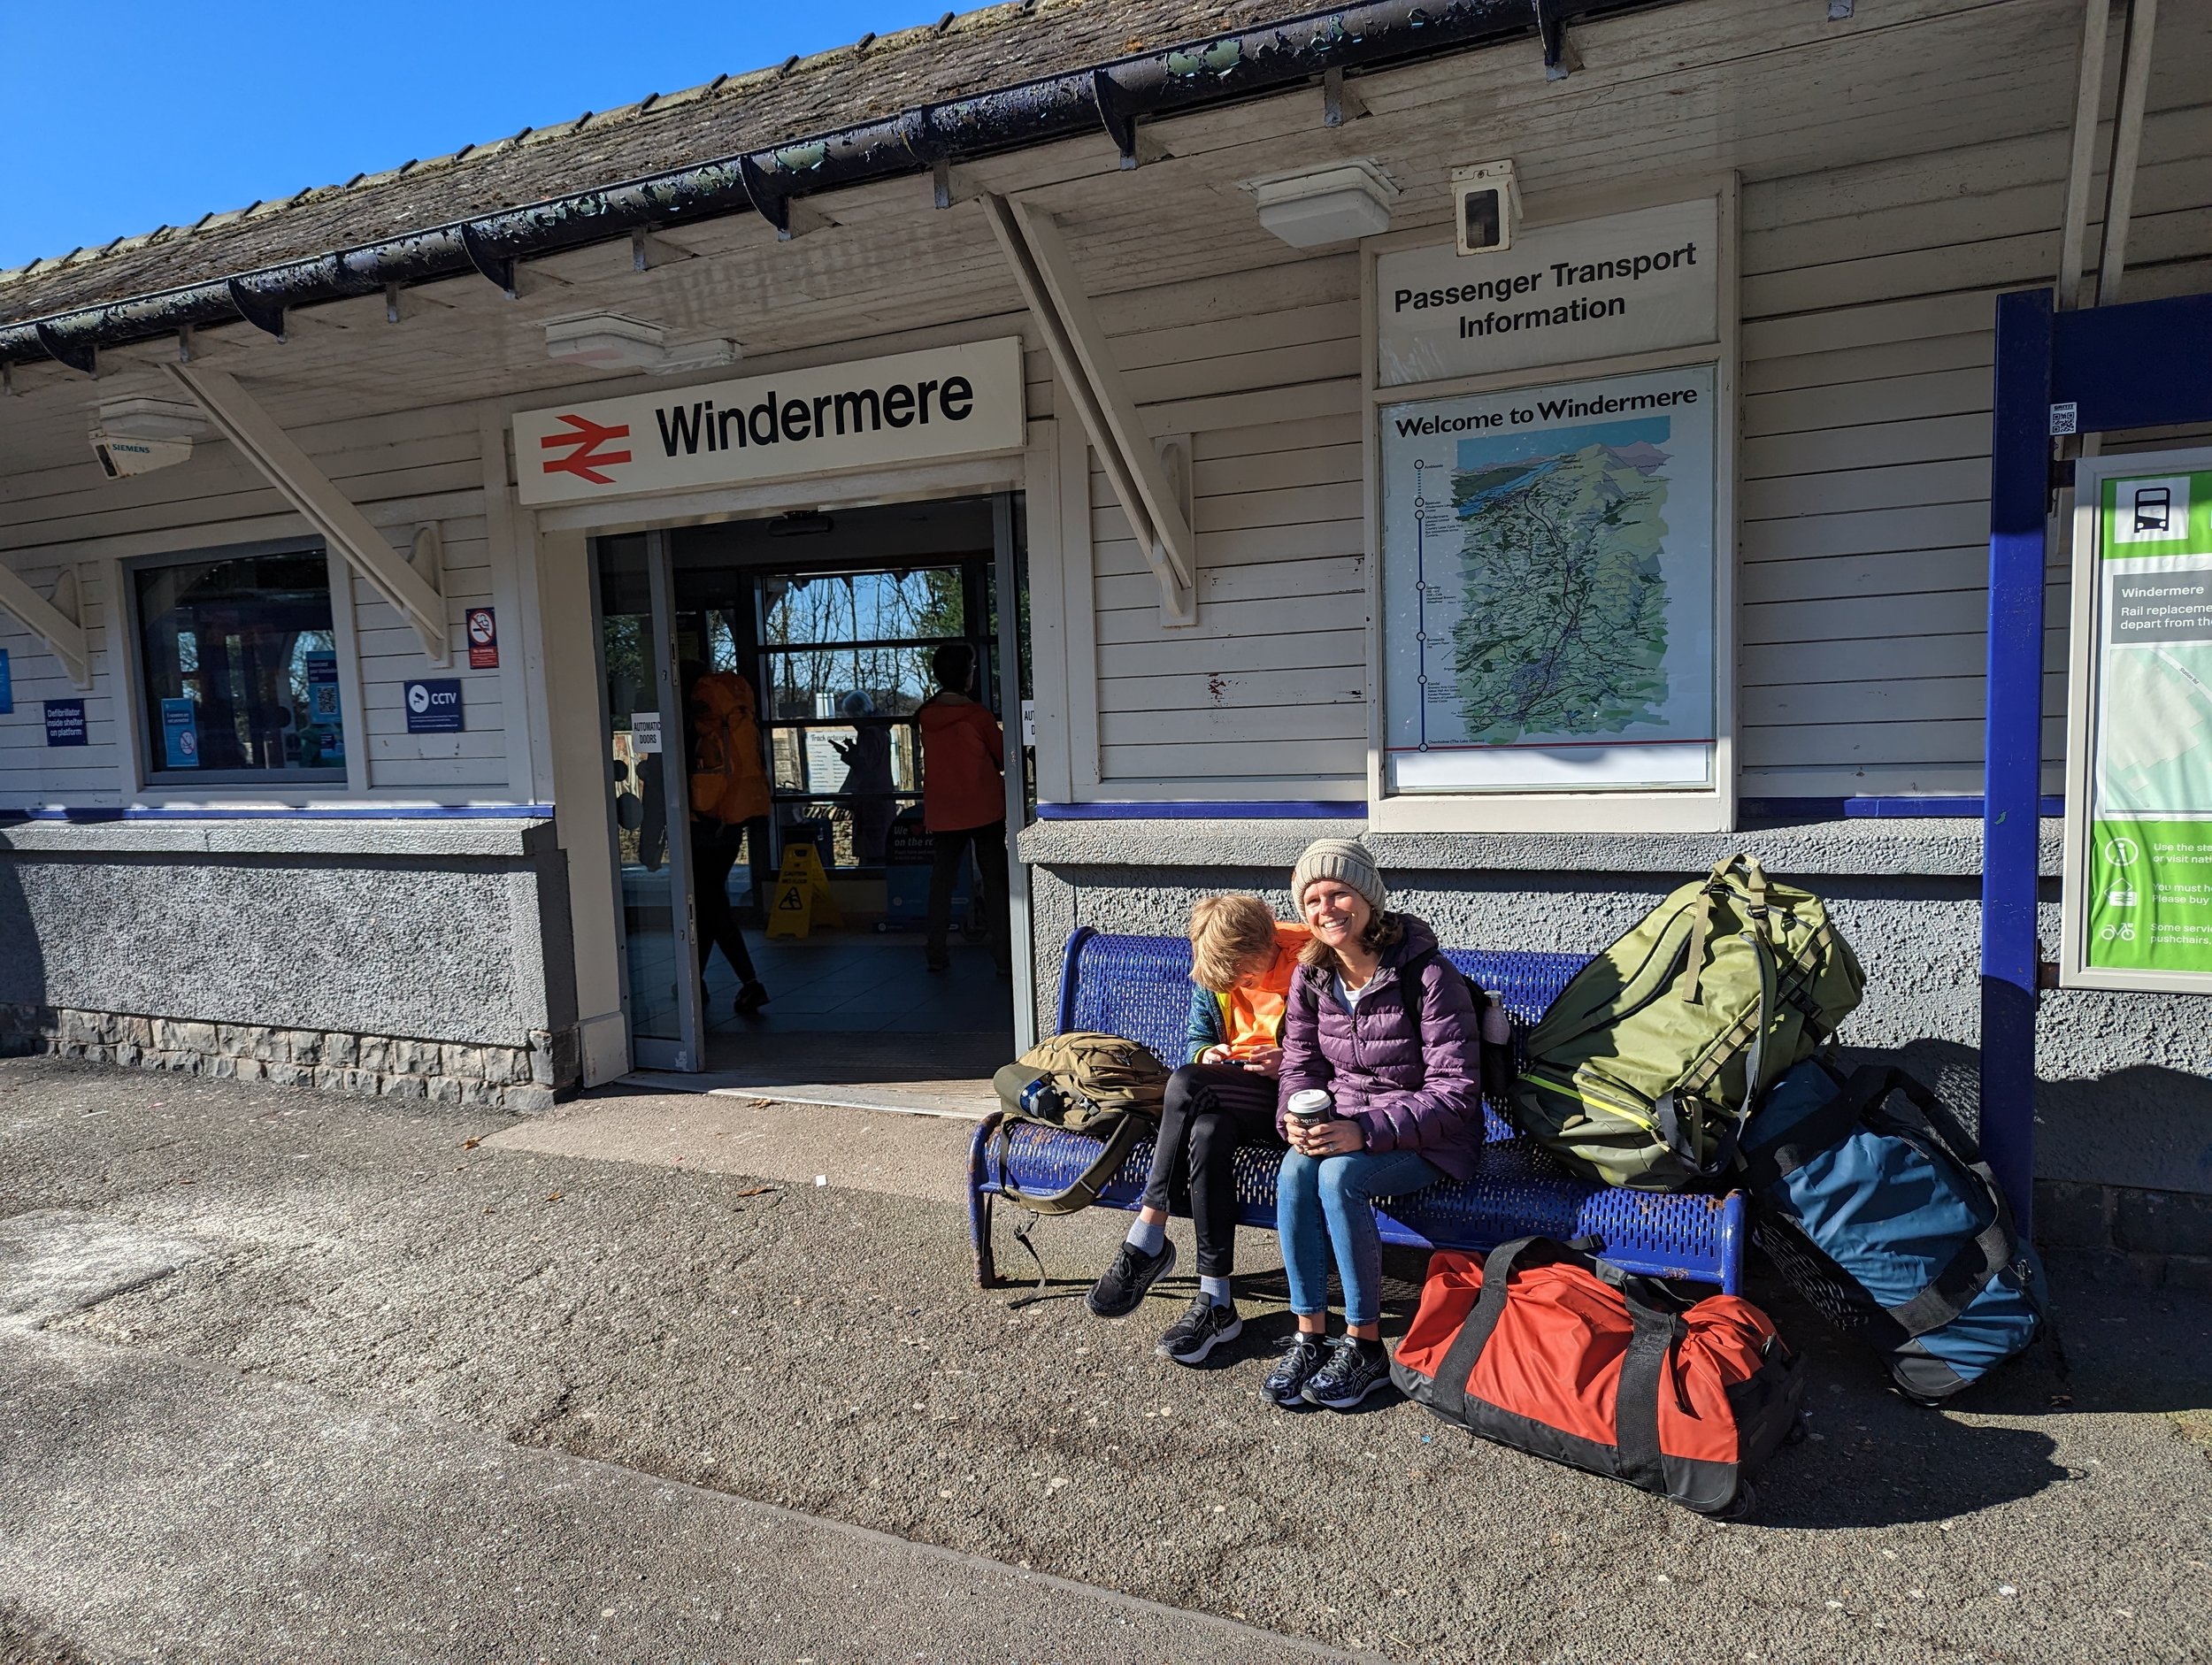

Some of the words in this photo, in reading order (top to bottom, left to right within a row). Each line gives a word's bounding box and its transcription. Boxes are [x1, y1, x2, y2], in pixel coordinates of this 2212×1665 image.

[1394, 272, 1542, 314] Passenger
[1550, 242, 1697, 288] Transport
[1460, 296, 1625, 339] Information
[655, 375, 973, 457] Windermere
[1395, 413, 1503, 438] Welcome
[1509, 407, 1534, 425] to
[1537, 388, 1698, 421] Windermere
[112, 444, 150, 454] SIEMENS
[2121, 586, 2204, 598] Windermere
[2121, 605, 2143, 616] Rail
[2146, 604, 2212, 617] replaceme
[2120, 618, 2162, 631] depart
[2164, 618, 2194, 627] from
[2197, 617, 2212, 626] th
[2179, 667, 2193, 680] Station
[431, 692, 457, 705] CCTV
[47, 709, 81, 717] Defibrillator
[47, 718, 64, 727] inside
[64, 717, 83, 726] shelter
[634, 721, 662, 732] AUTOMATIC
[58, 727, 82, 738] platform
[639, 734, 657, 744] DOORS
[894, 825, 909, 835] We
[908, 836, 923, 847] the
[2154, 842, 2174, 851] Use
[2177, 843, 2194, 852] the
[2166, 855, 2189, 863] visit
[2191, 855, 2212, 863] nati
[2153, 883, 2171, 892] You
[2174, 884, 2202, 893] must
[2152, 894, 2186, 903] Please
[2189, 895, 2209, 906] buy
[2150, 935, 2212, 945] pushchairs,
